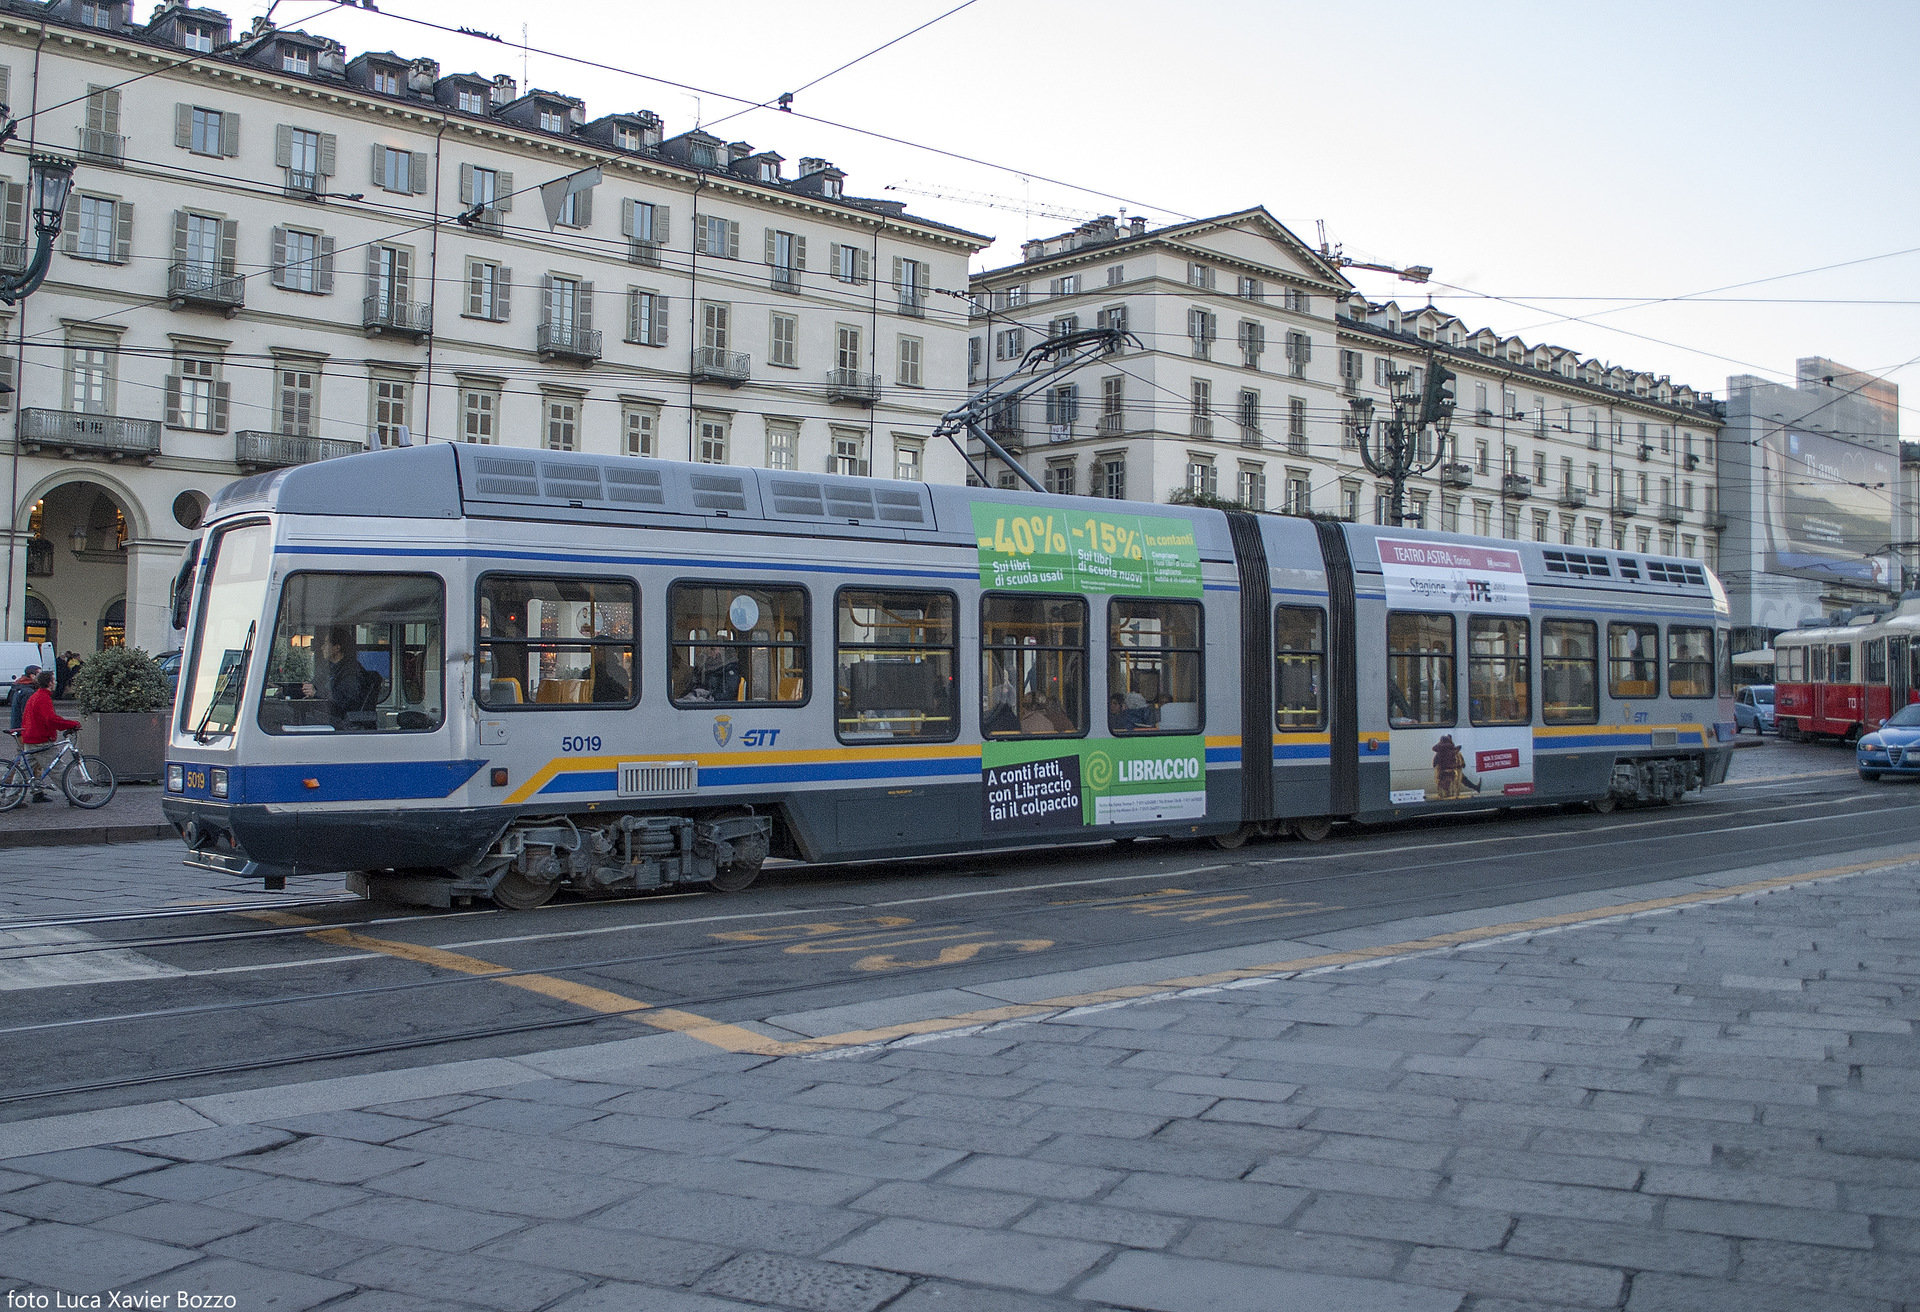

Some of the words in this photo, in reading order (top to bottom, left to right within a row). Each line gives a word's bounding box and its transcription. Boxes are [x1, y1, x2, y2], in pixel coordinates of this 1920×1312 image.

[978, 515, 1066, 556] -40%
[1072, 519, 1142, 561] -15%
[1145, 534, 1157, 547] In
[1157, 533, 1194, 546] contanti
[993, 561, 1009, 573] Sui
[1010, 559, 1031, 571] libri
[1077, 549, 1093, 561] Sui
[1094, 552, 1112, 565] libri
[1393, 547, 1425, 563] TEATRO
[1426, 550, 1453, 567] ASTRA
[995, 574, 1004, 587] di
[1006, 573, 1039, 585] scuola
[1041, 570, 1064, 582] usati
[1078, 561, 1088, 572] di
[1089, 563, 1118, 577] scuola
[1119, 571, 1143, 584] nuovi
[1409, 577, 1447, 597] Stagione
[1466, 579, 1492, 603] TPE
[562, 735, 602, 752] 5019
[740, 729, 781, 747] GTT
[186, 771, 205, 789] 5019
[987, 769, 998, 786] A
[1000, 764, 1032, 784] conti
[1032, 760, 1063, 780] fatti,
[1118, 757, 1199, 782] LIBRACCIO
[989, 787, 1012, 803] con
[1014, 777, 1072, 799] Libraccio
[989, 803, 1007, 821] fai
[1009, 801, 1019, 817] il
[1021, 794, 1078, 816] colpaccio
